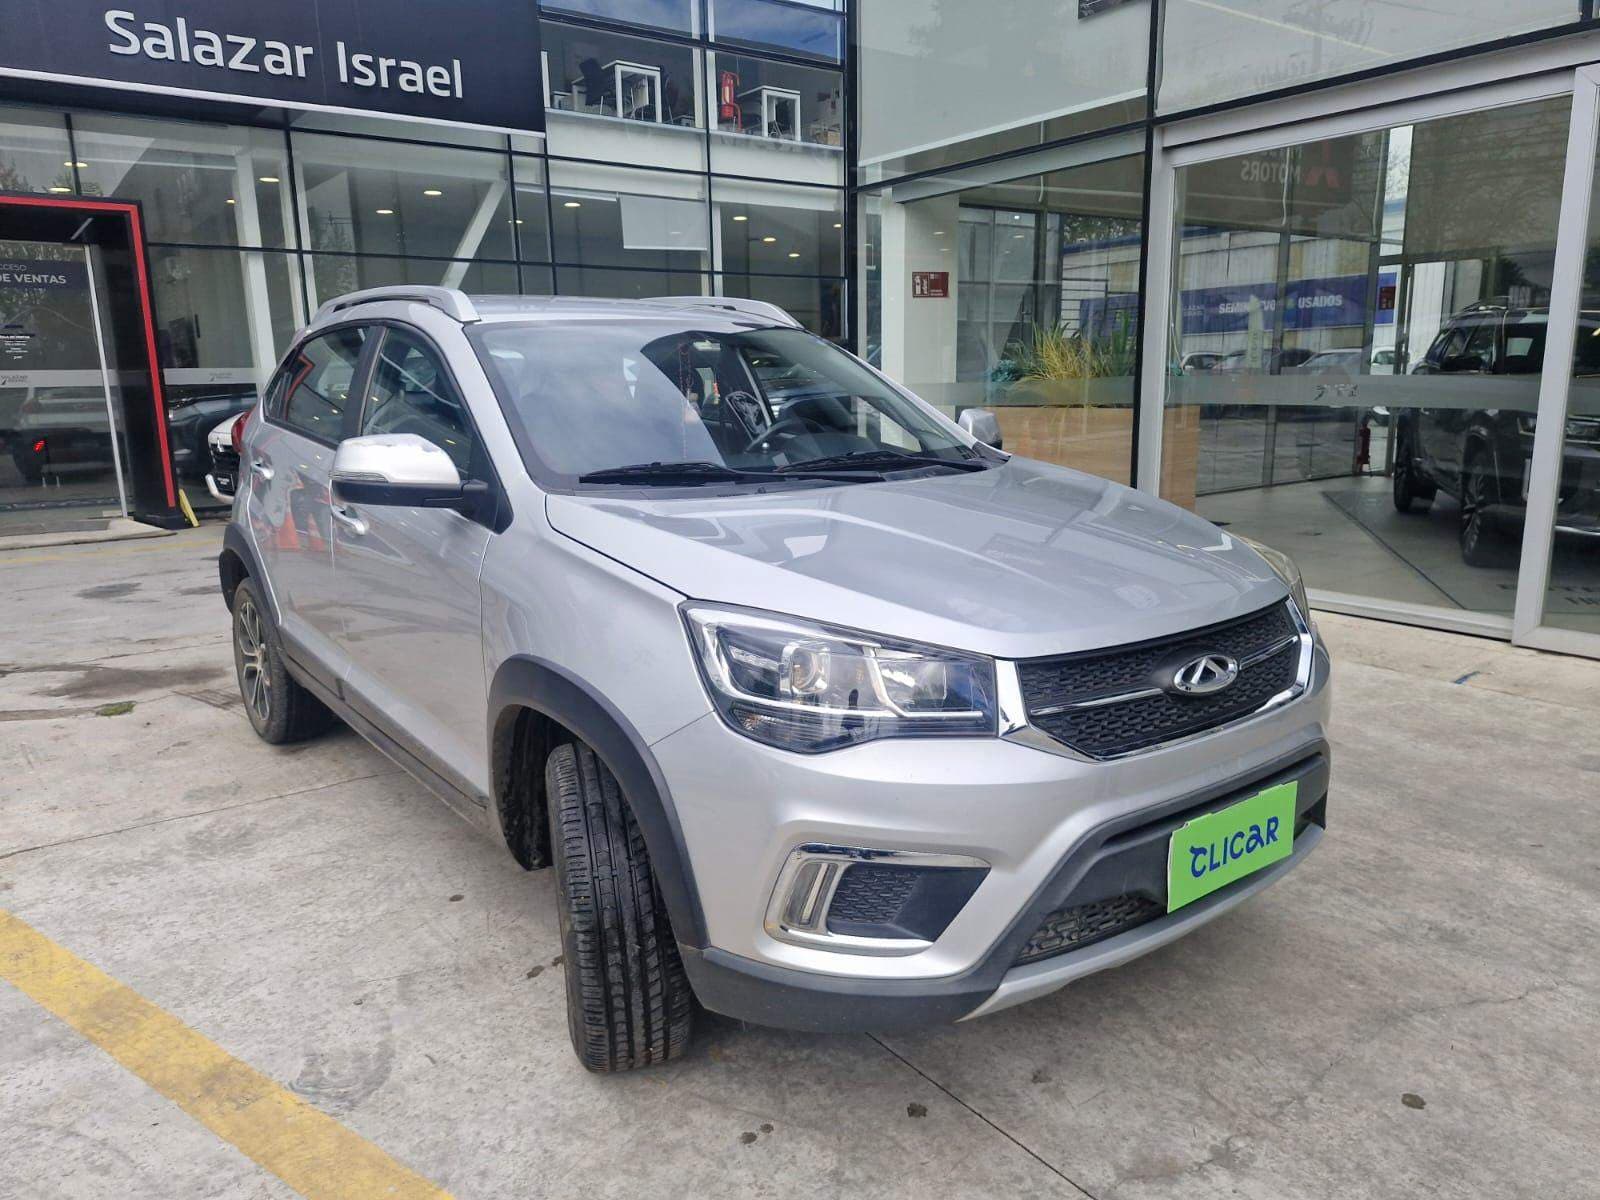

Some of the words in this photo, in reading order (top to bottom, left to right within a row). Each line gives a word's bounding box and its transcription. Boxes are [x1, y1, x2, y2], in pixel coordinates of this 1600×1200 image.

[104, 9, 313, 77] Salazar
[336, 41, 463, 98] Israel
[14, 274, 67, 284] VENTAS
[1298, 295, 1343, 308] USADOS
